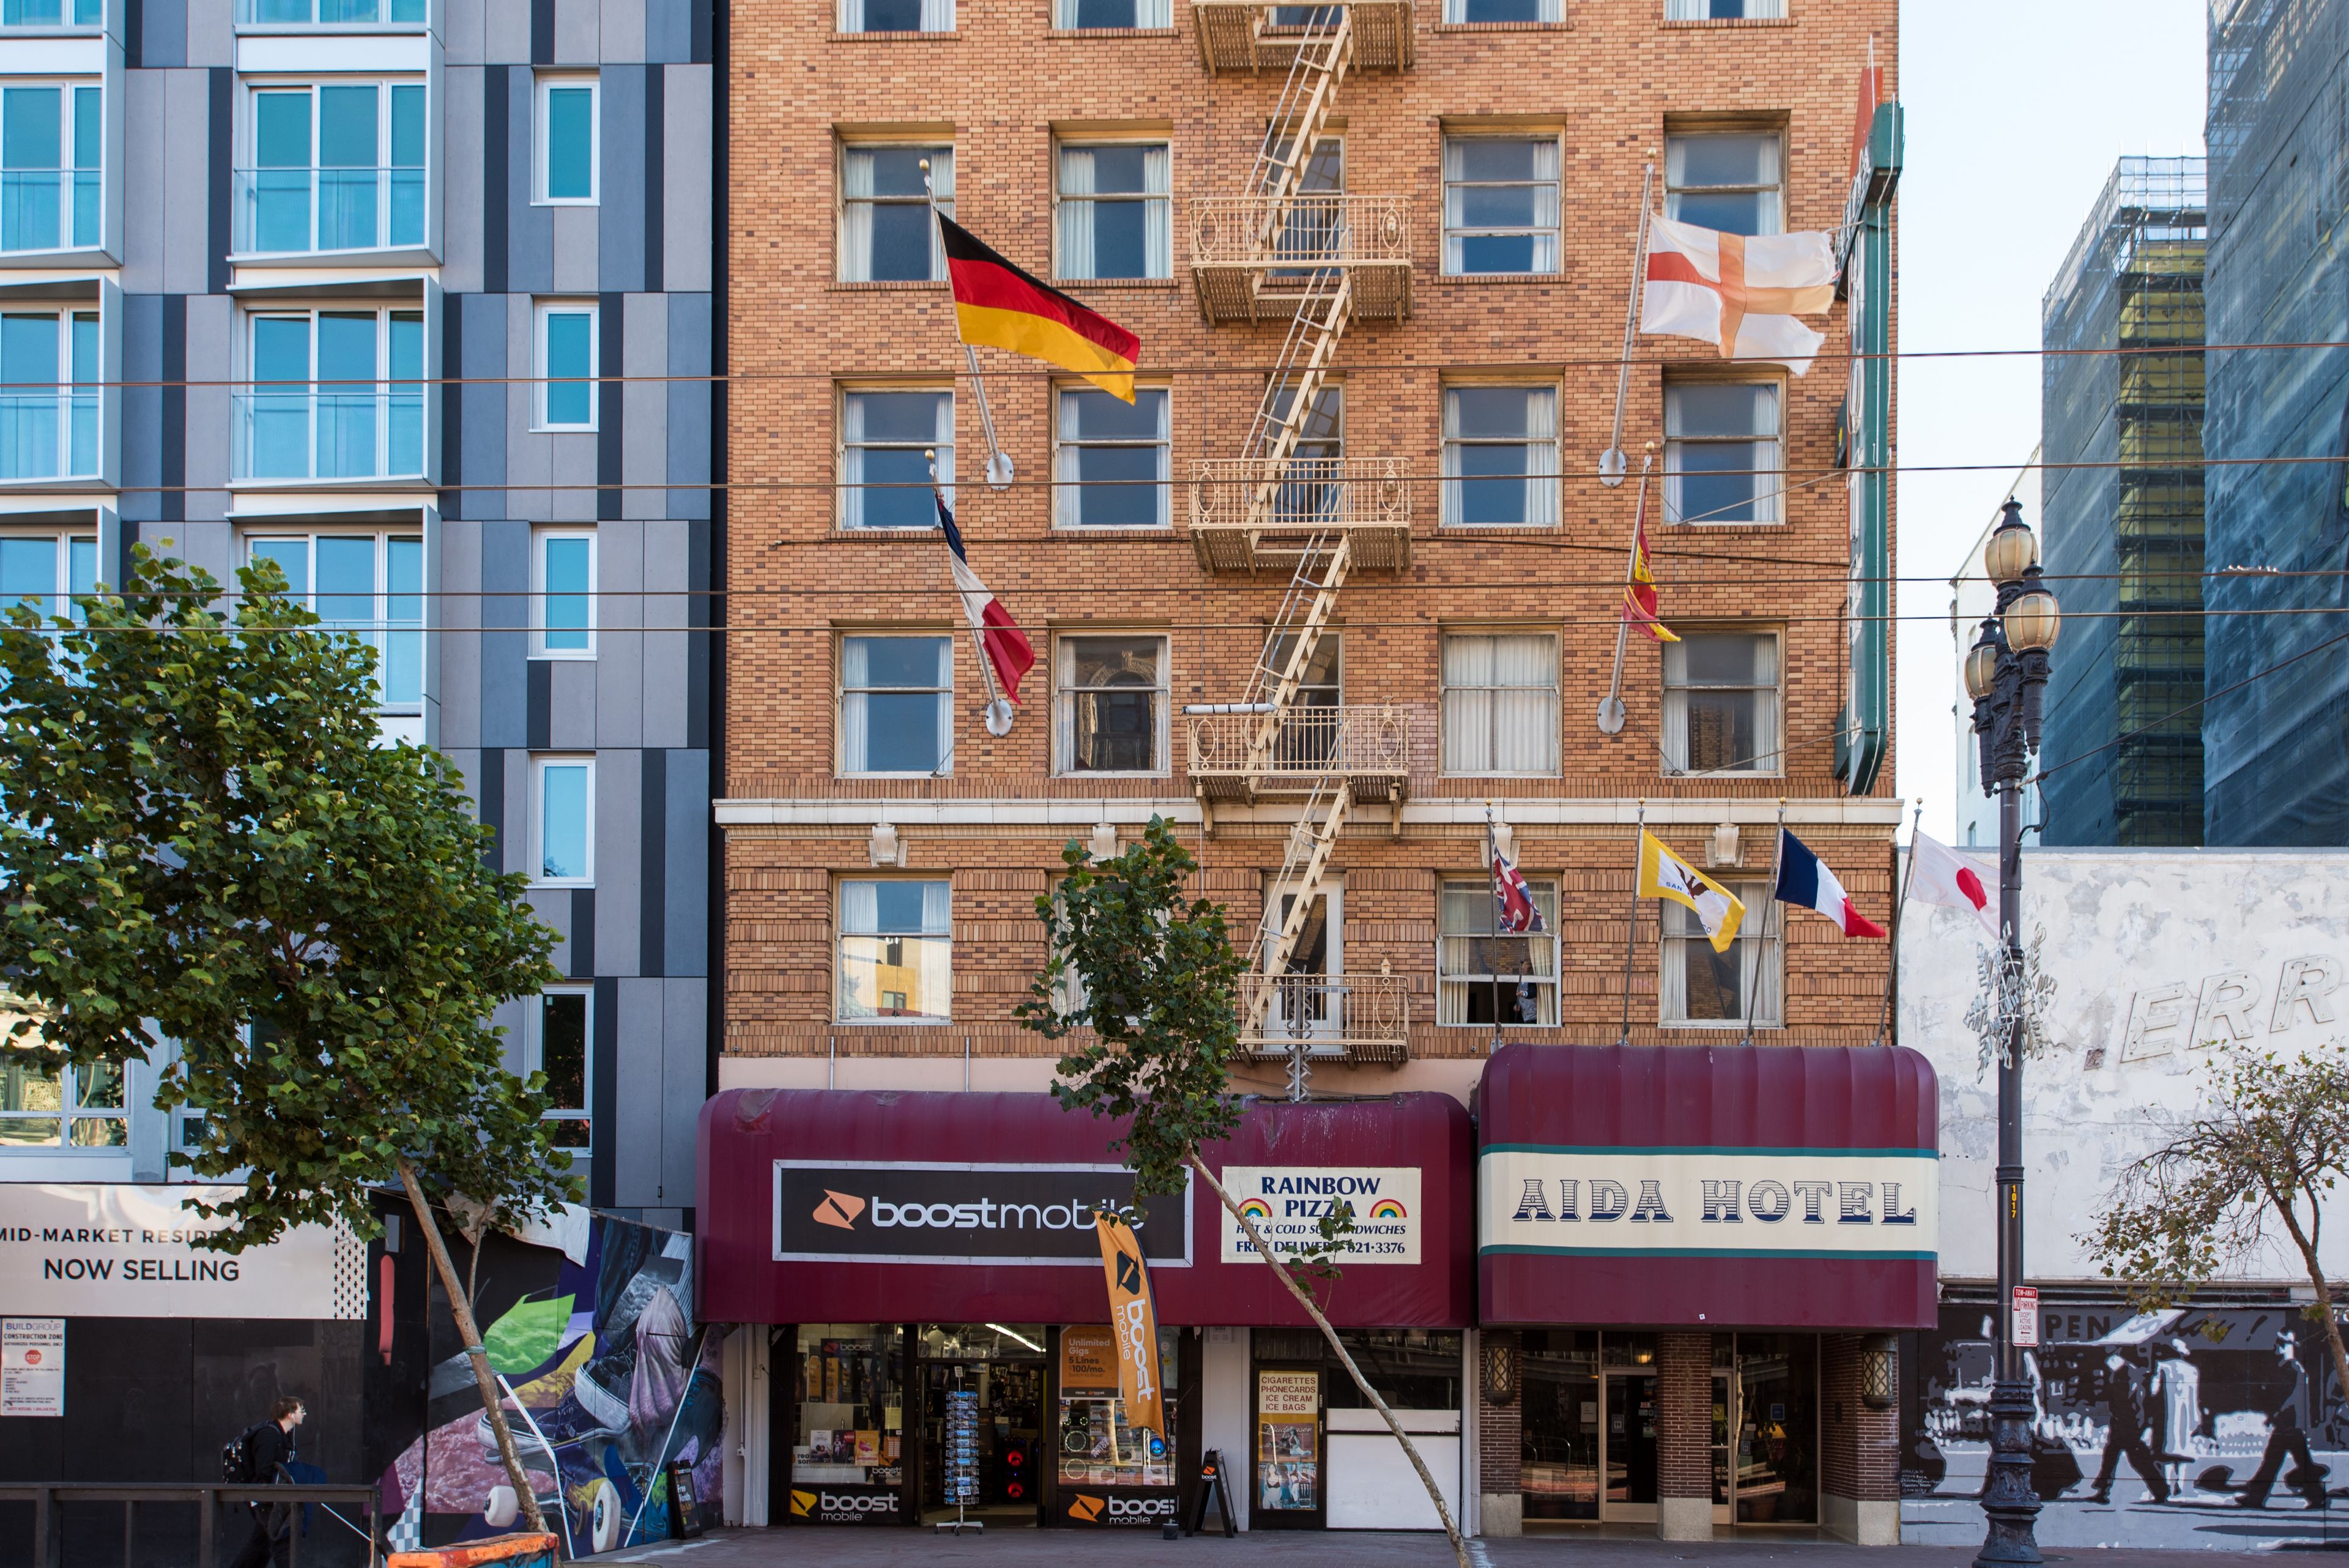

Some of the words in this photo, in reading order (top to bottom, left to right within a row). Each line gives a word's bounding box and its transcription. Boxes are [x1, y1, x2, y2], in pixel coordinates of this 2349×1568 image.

[1666, 882, 1682, 891] SAN
[1261, 1177, 1381, 1195] RAINBOW
[1512, 1180, 1674, 1222] AIDA
[1701, 1180, 1916, 1225] HOTEL
[1236, 1225, 1261, 1234] HT
[1264, 1225, 1271, 1234] &
[1275, 1224, 1306, 1234] COLD
[44, 1259, 114, 1280] NOW
[123, 1259, 240, 1281] SELLING
[2014, 1297, 2021, 1310] NO
[2021, 1301, 2035, 1310] PARKING
[1116, 1305, 1131, 1360] mobile
[1069, 1347, 1089, 1356] Gigs
[1127, 1299, 1155, 1403] boost
[822, 1492, 898, 1512] boost
[1108, 1496, 1179, 1515] boos
[822, 1512, 863, 1521] mobile
